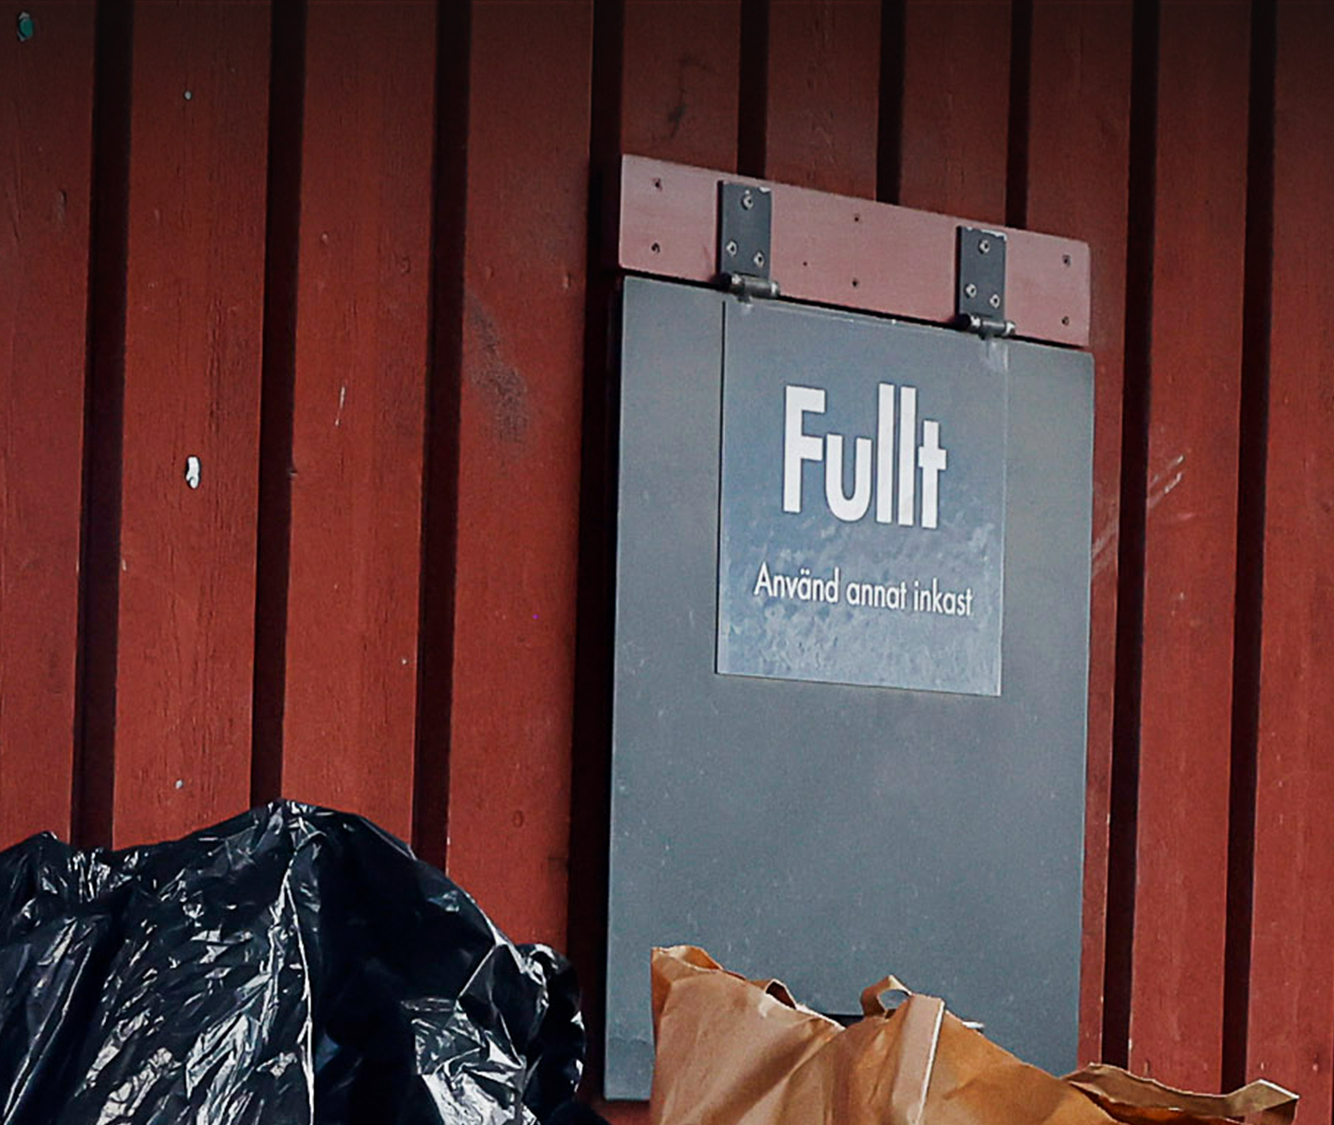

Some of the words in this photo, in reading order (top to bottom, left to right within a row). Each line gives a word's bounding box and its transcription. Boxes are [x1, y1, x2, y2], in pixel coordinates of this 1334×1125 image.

[783, 382, 947, 529] Fullt
[754, 561, 839, 603] Använd
[846, 581, 907, 610] annat
[913, 578, 973, 616] inkast
